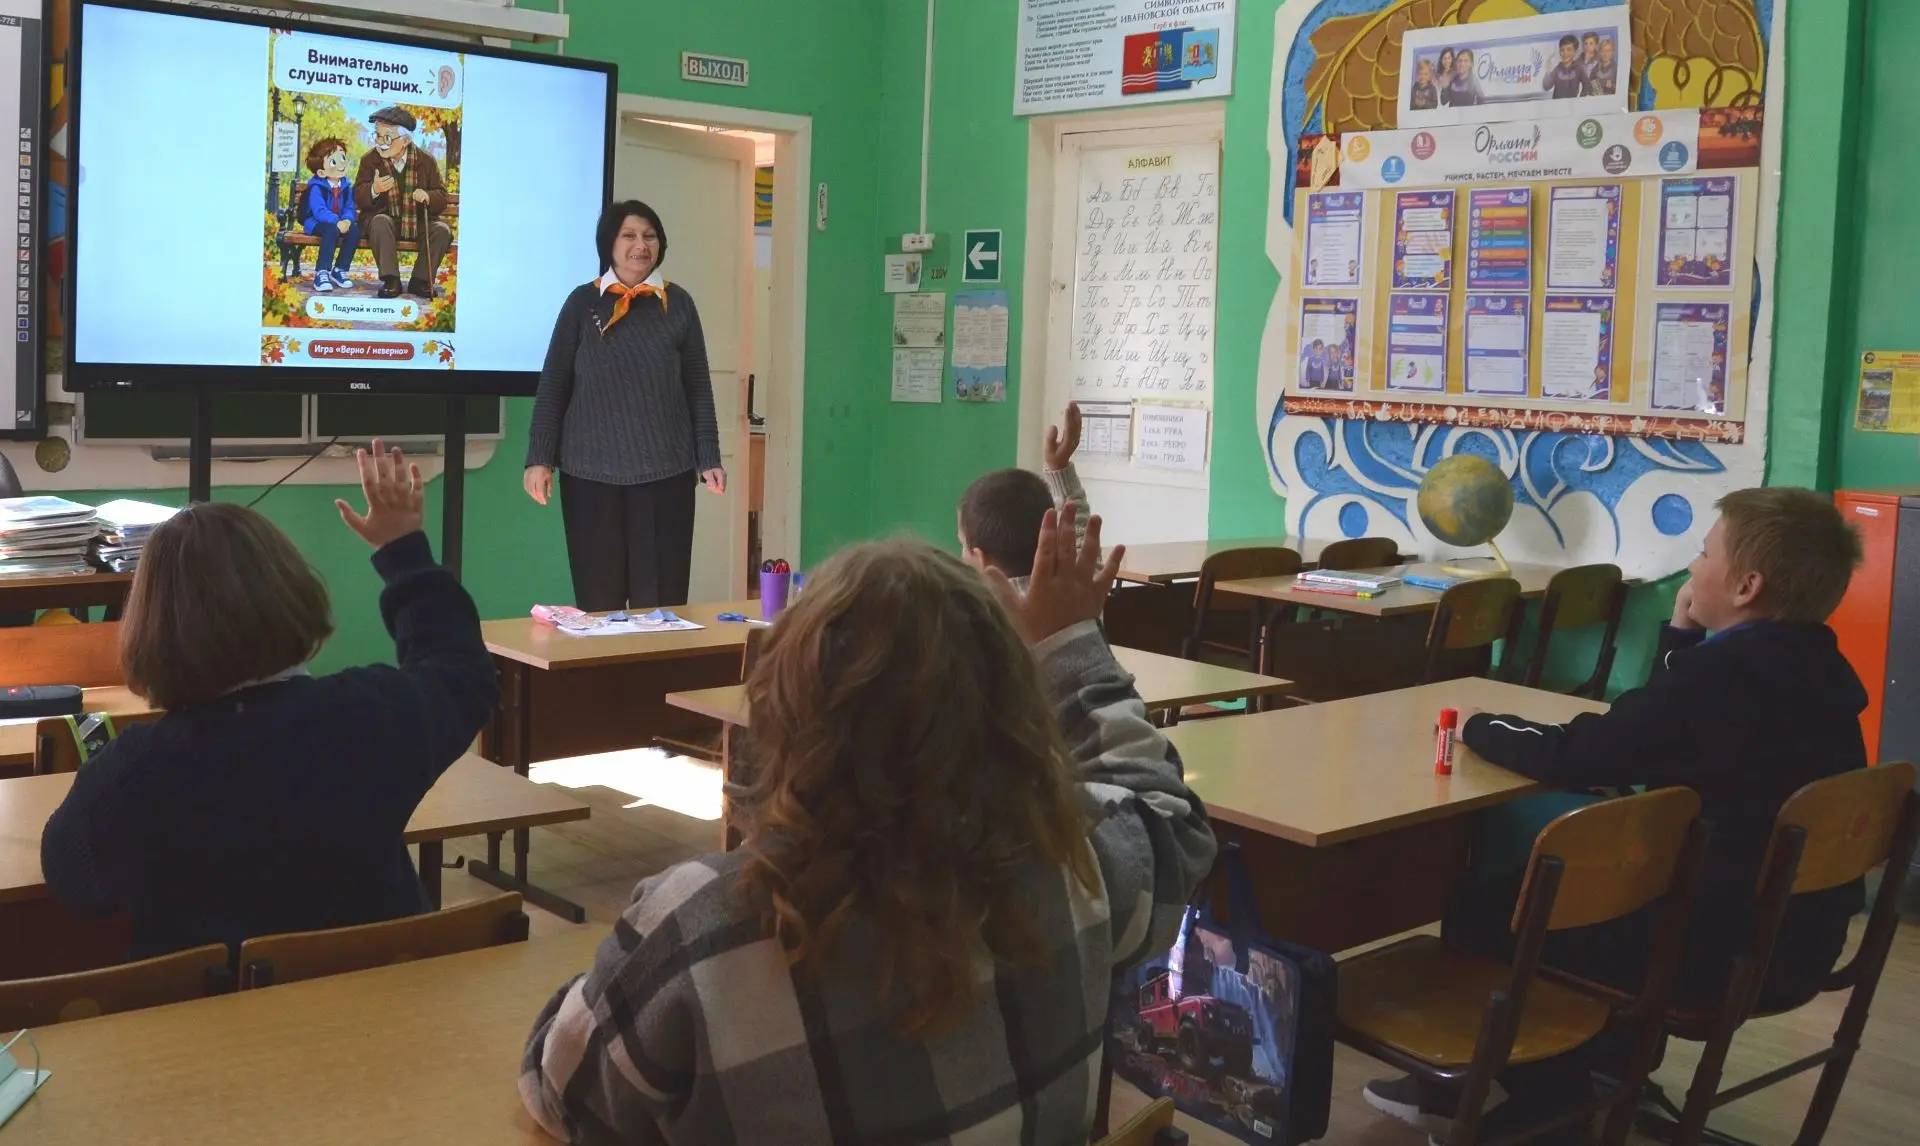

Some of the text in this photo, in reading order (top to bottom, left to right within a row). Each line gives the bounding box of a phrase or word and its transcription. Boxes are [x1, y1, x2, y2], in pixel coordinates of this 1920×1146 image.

[1120, 7, 1180, 23] ИВАНОВСКОЙ
[1182, 1, 1225, 14] ОБЛАСТИ
[307, 48, 409, 75] Внимательно
[689, 59, 742, 82] ВЫХОД
[288, 67, 423, 94] слушать старших.
[1127, 155, 1172, 169] АЛФАВИТ
[1507, 169, 1542, 178] МЕЧТАЕМ
[1543, 167, 1573, 176] ВМЕСТЕ
[332, 303, 365, 314] Подумай
[372, 307, 395, 315] ответь
[314, 344, 334, 356] Игра
[335, 345, 364, 356] «Верно
[372, 347, 409, 357] неверно»
